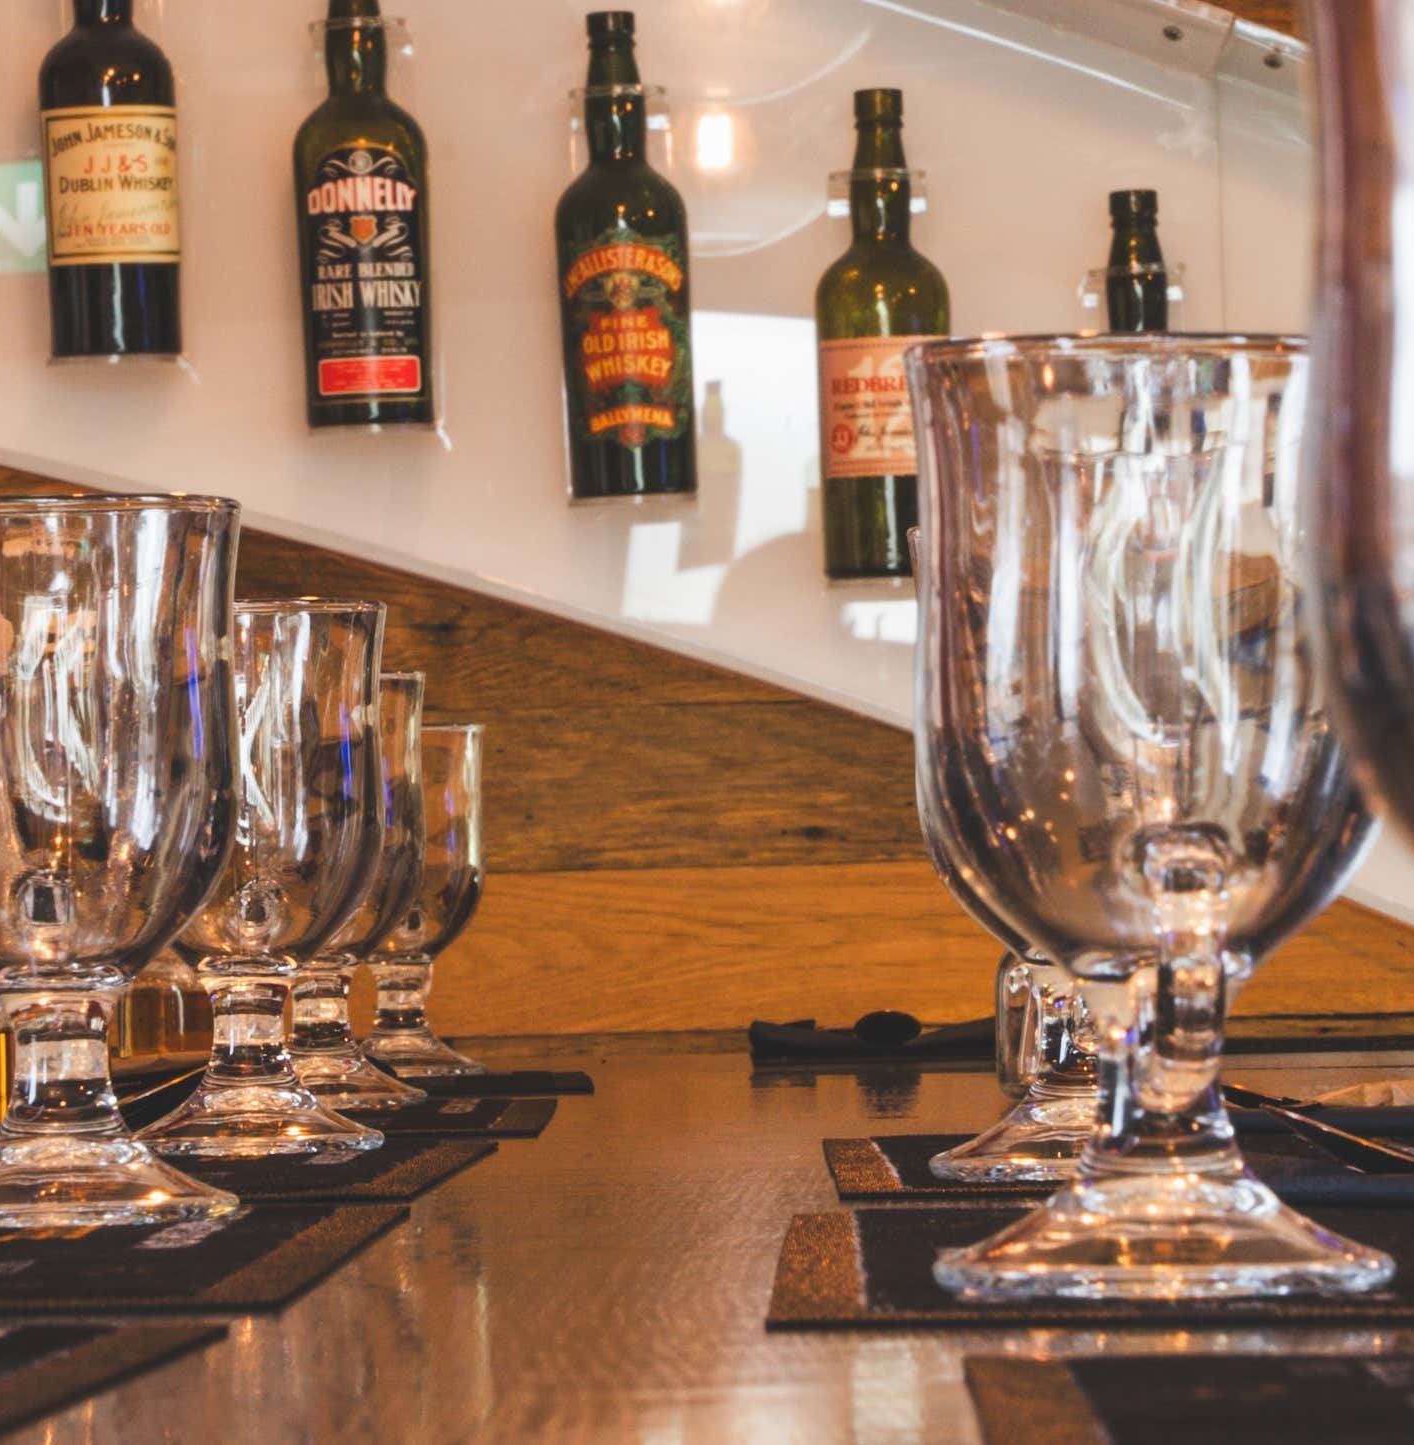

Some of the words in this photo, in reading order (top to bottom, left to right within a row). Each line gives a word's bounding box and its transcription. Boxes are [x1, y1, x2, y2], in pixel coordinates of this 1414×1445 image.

[50, 130, 84, 157] JOHN
[86, 122, 151, 143] JAMESON
[58, 175, 114, 195] DUBLIN
[118, 173, 173, 192] WHISKEY
[307, 175, 418, 216] DONNELLY
[99, 222, 147, 236] YEARS
[318, 263, 353, 280] RARE
[357, 261, 414, 278] BLENDED
[312, 282, 354, 311] IRISH
[358, 280, 423, 309] WHISKY
[600, 315, 649, 330] FINE
[582, 335, 615, 353] OLD
[618, 329, 670, 351] IRISH
[586, 352, 673, 383] WHISKEY
